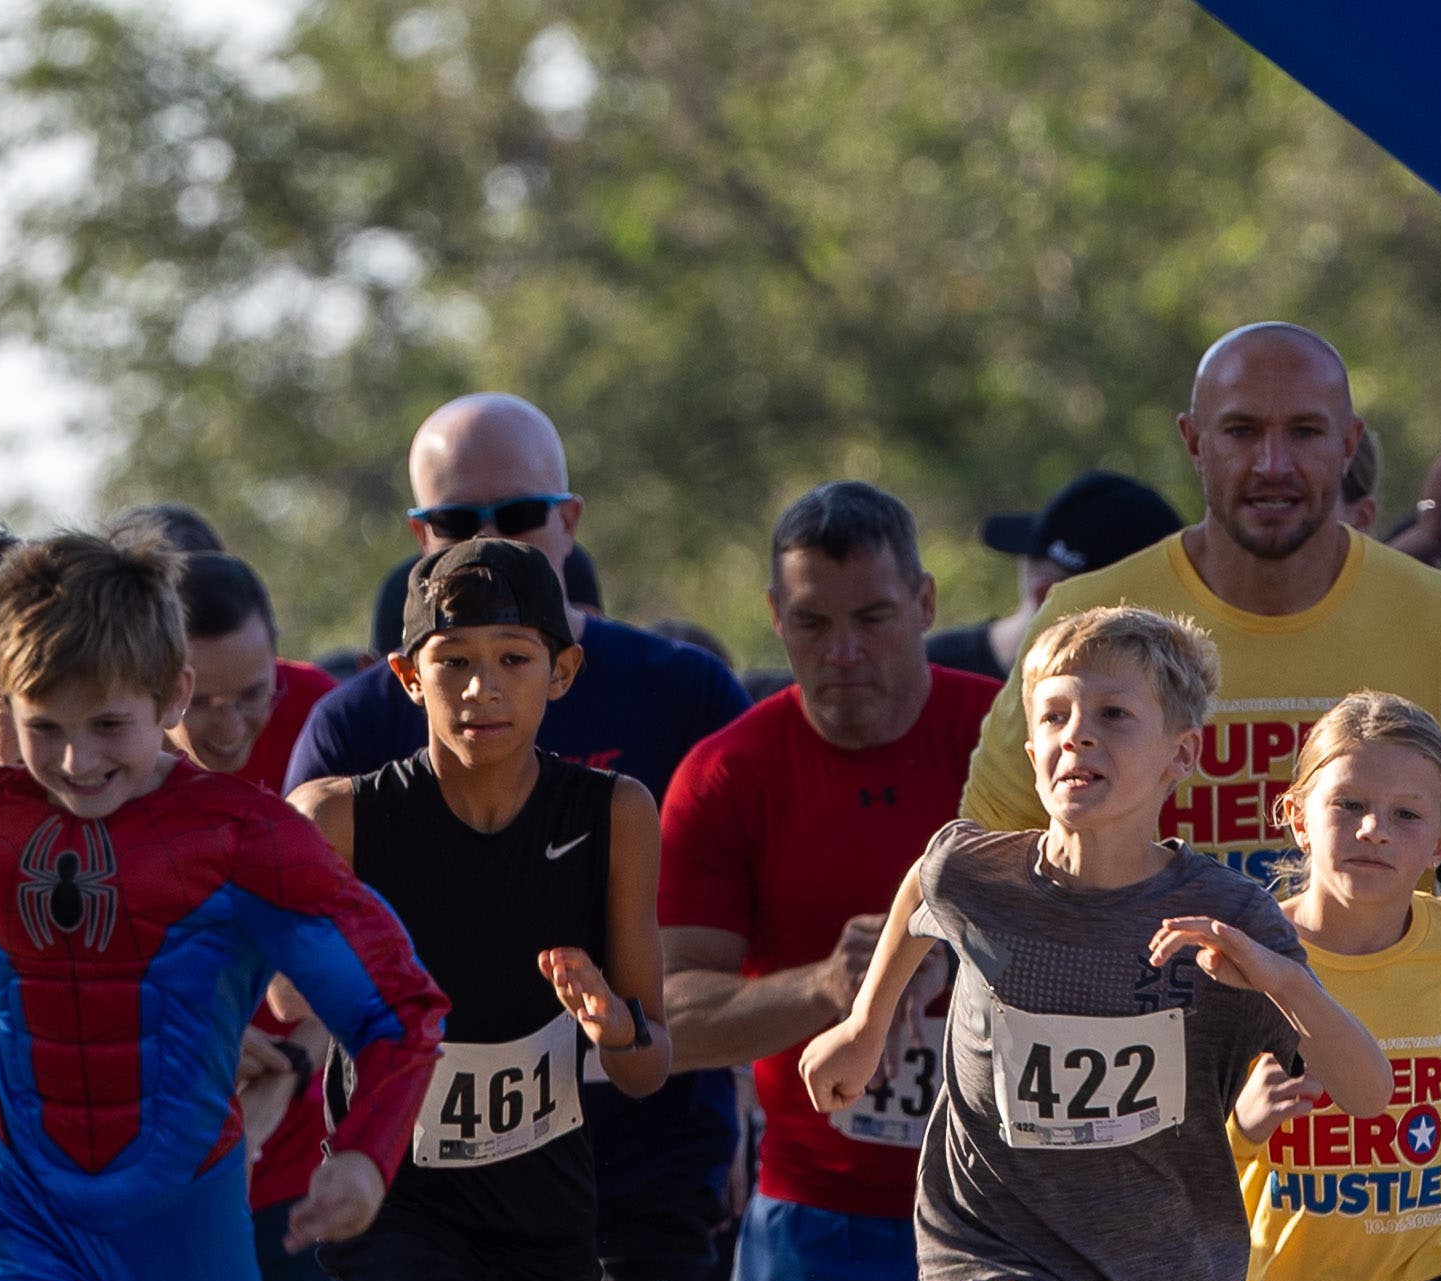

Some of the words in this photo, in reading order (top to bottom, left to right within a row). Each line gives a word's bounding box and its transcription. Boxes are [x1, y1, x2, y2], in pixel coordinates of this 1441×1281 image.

[1159, 780, 1292, 843] HE
[440, 1050, 557, 1139] 461
[1017, 1043, 1158, 1120] 422
